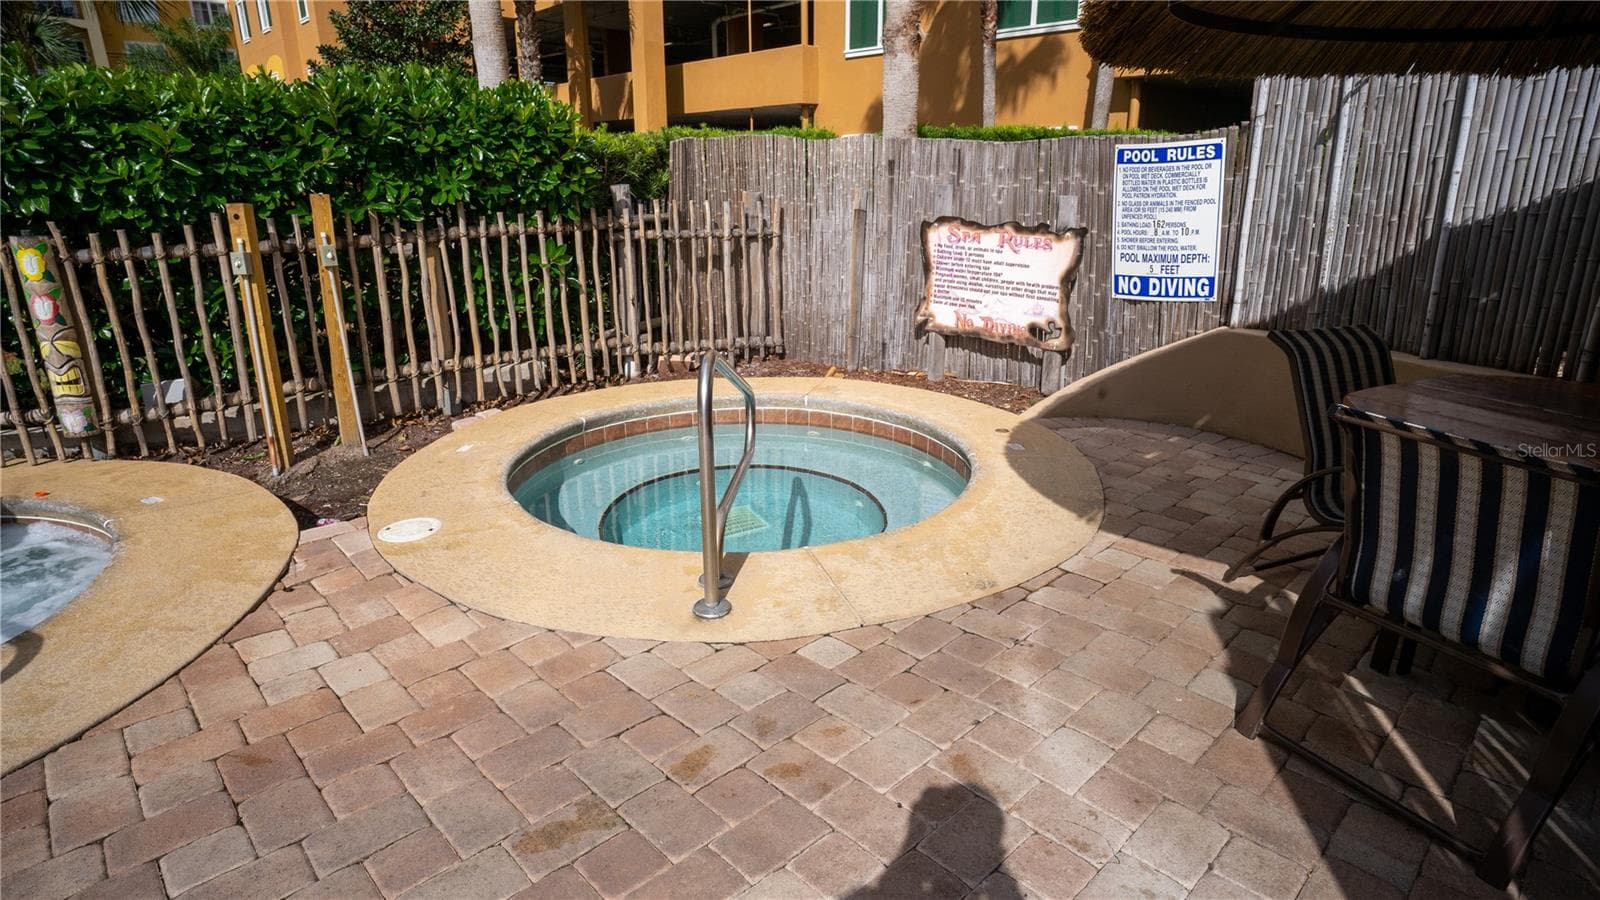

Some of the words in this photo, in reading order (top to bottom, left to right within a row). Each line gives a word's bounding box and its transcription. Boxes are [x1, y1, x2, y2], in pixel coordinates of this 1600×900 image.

[1124, 149, 1159, 162] POOL
[1167, 146, 1216, 160] RULES
[1120, 253, 1140, 262] POOL
[1142, 253, 1179, 263] MAXIMUM
[1181, 254, 1210, 263] DEPTH:
[1160, 265, 1180, 274] FEET
[1118, 276, 1142, 294] NO
[1149, 278, 1210, 297] DIVING
